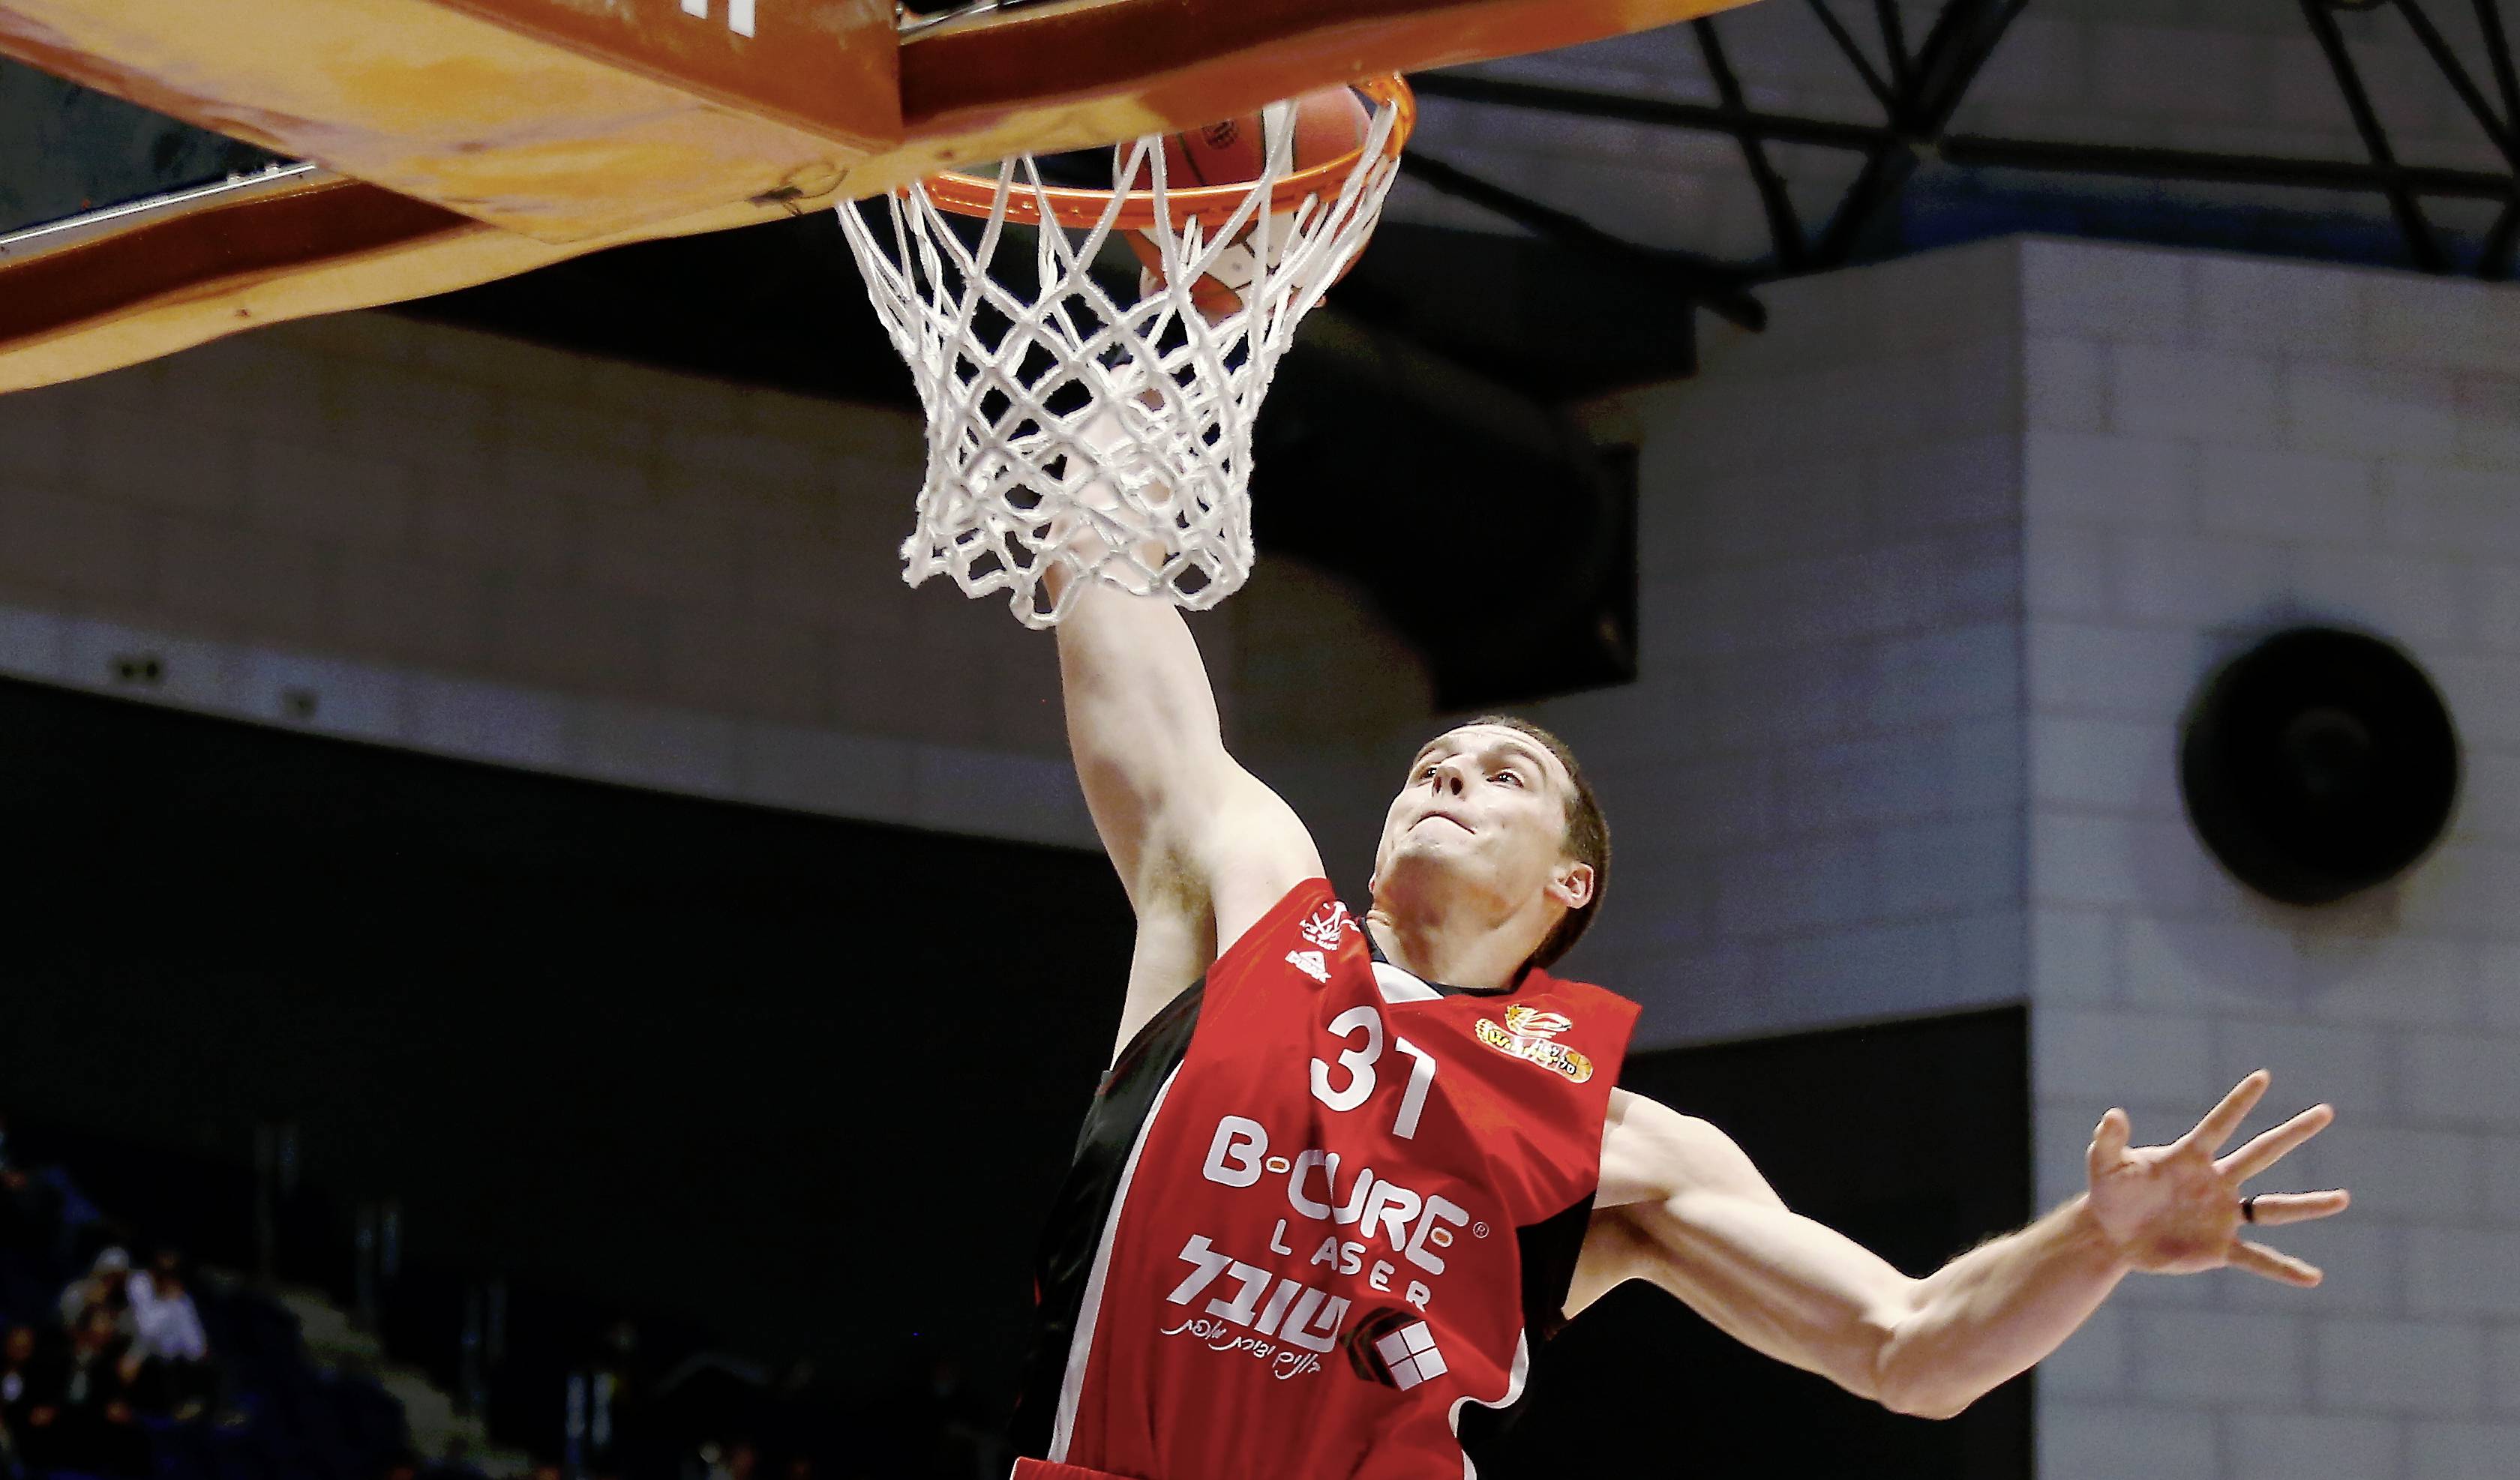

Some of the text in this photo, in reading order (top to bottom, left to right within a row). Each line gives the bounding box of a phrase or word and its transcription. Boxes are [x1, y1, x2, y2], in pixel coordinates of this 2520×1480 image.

[1310, 1005, 1437, 1140] 31
[1203, 1115, 1470, 1275] B-CURE
[1166, 1233, 1352, 1353] שובל
[1270, 1219, 1432, 1314] LASER
